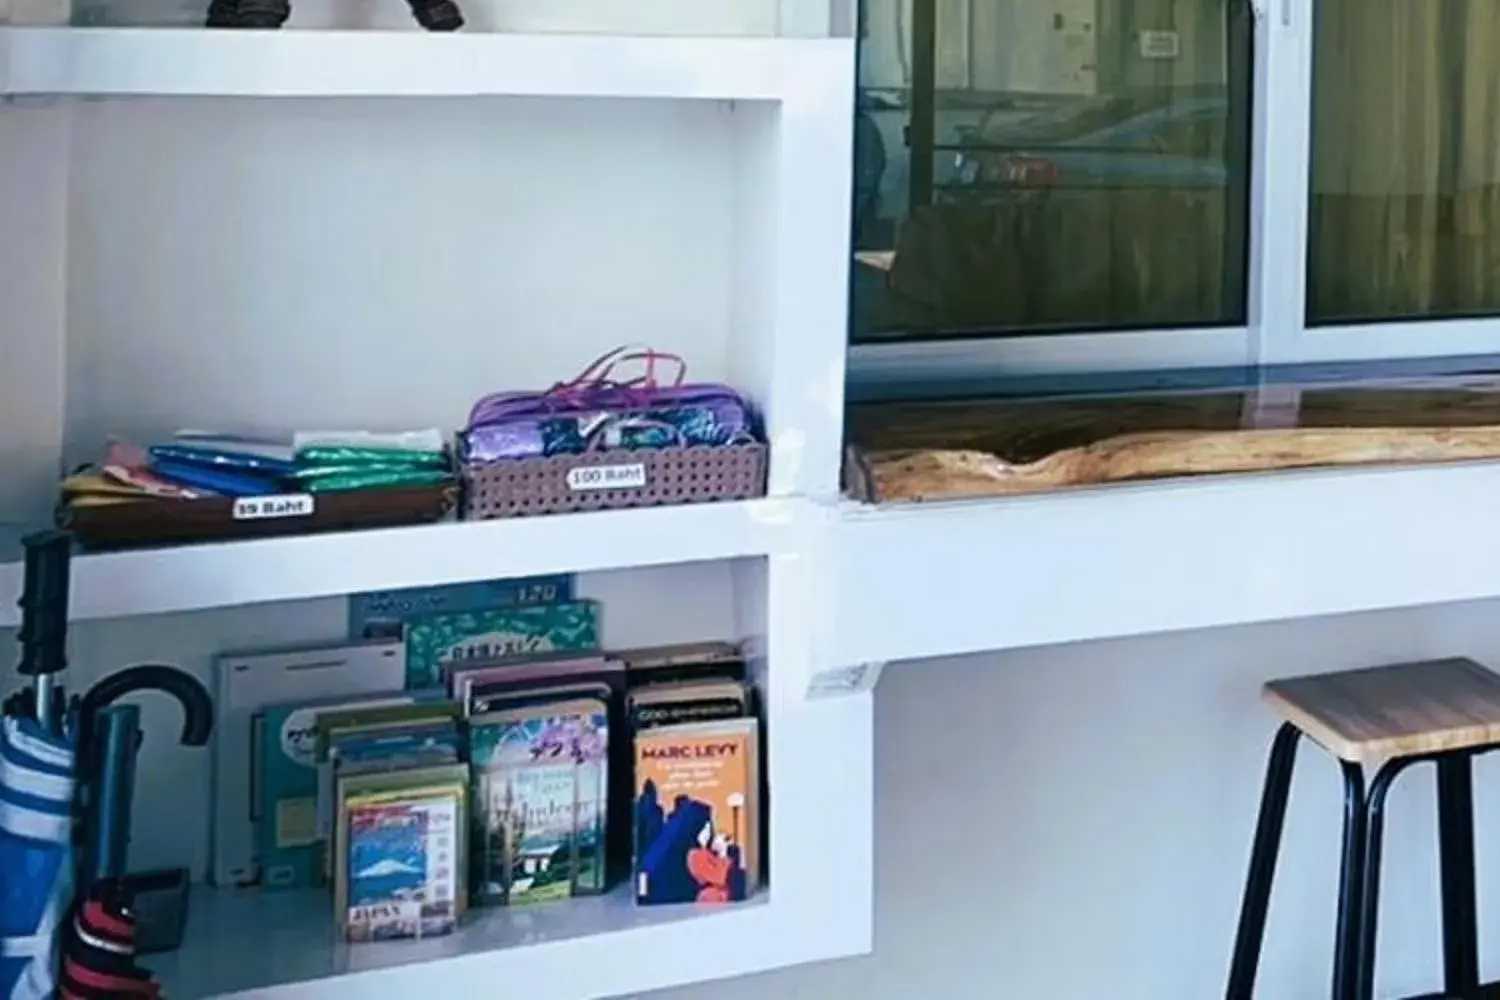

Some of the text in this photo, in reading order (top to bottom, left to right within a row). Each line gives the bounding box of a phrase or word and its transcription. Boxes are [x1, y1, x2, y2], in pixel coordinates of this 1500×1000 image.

[573, 467, 642, 484] 100 Baht
[262, 500, 304, 514] Baht
[641, 742, 739, 760] MARC LEVY
